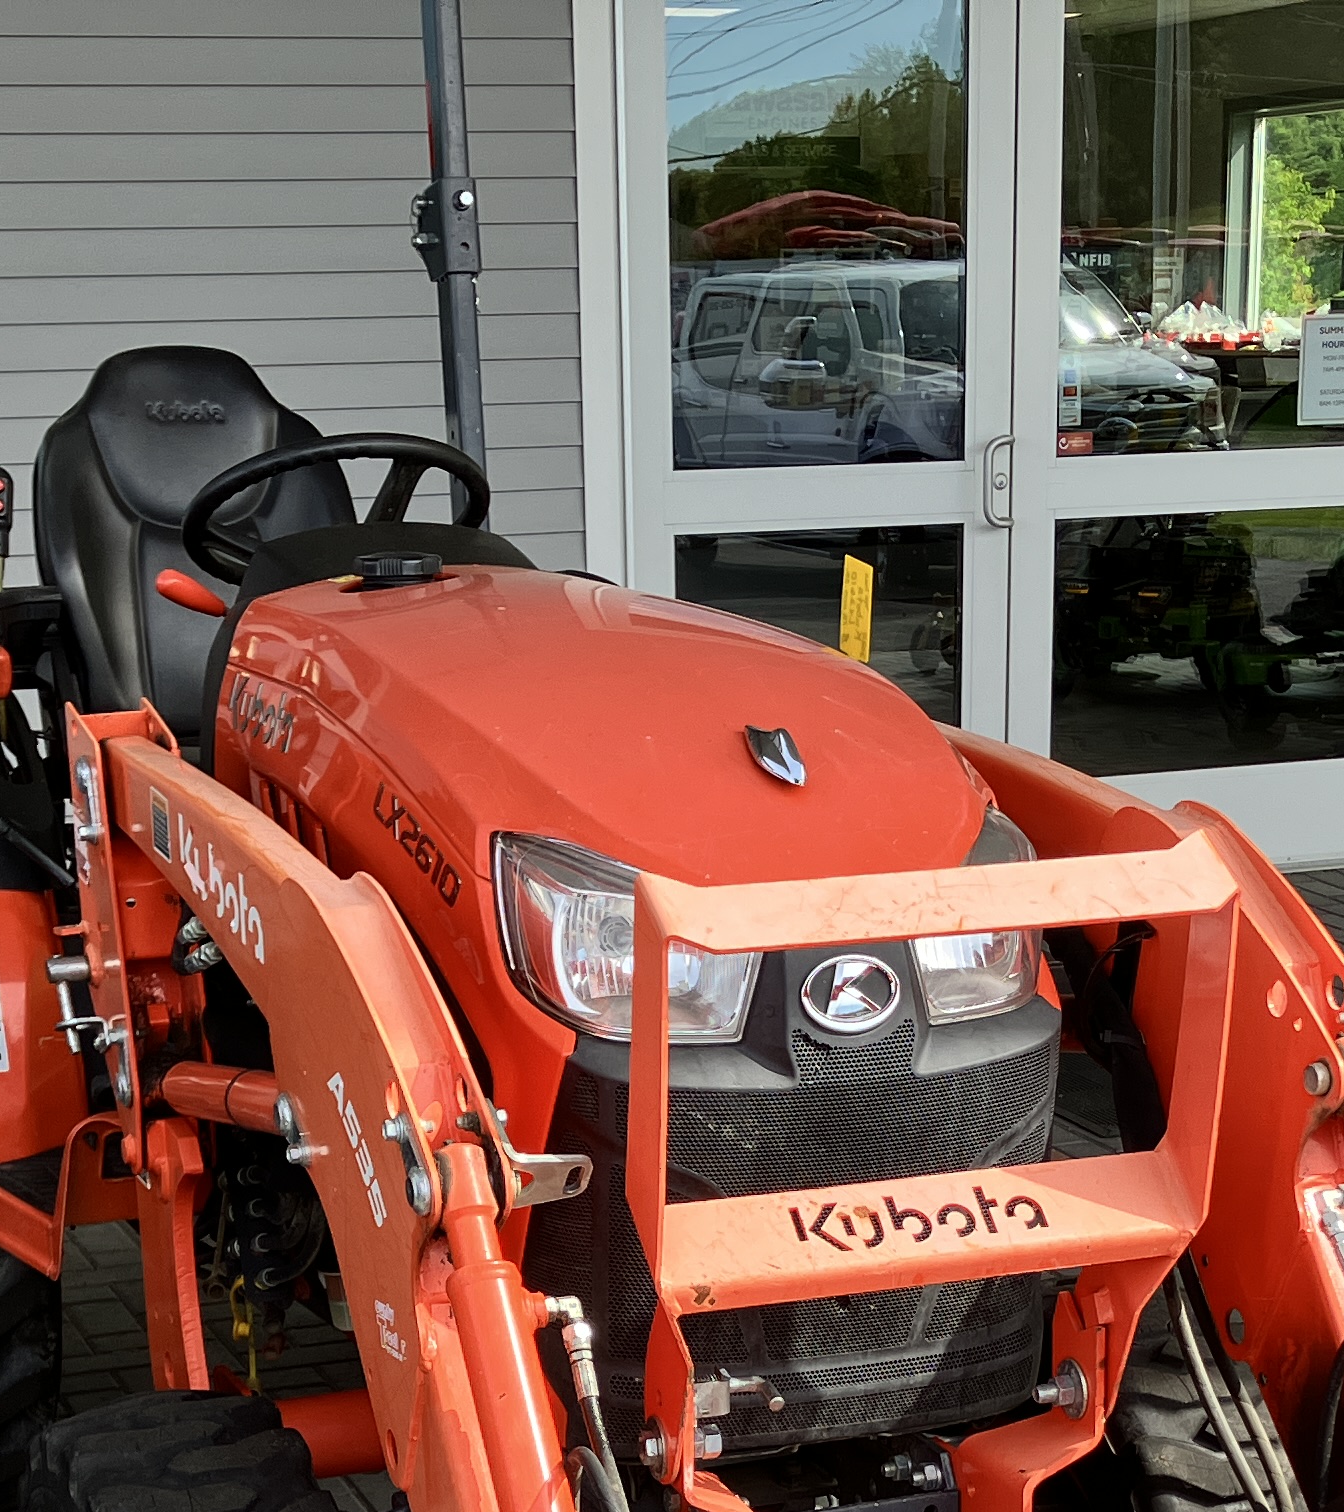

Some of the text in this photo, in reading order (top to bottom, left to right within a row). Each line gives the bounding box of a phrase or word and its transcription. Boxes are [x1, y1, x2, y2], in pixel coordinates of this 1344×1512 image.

[1079, 253, 1111, 266] NFIB
[373, 782, 462, 908] LX2610
[788, 1186, 1050, 1251] Kubota
